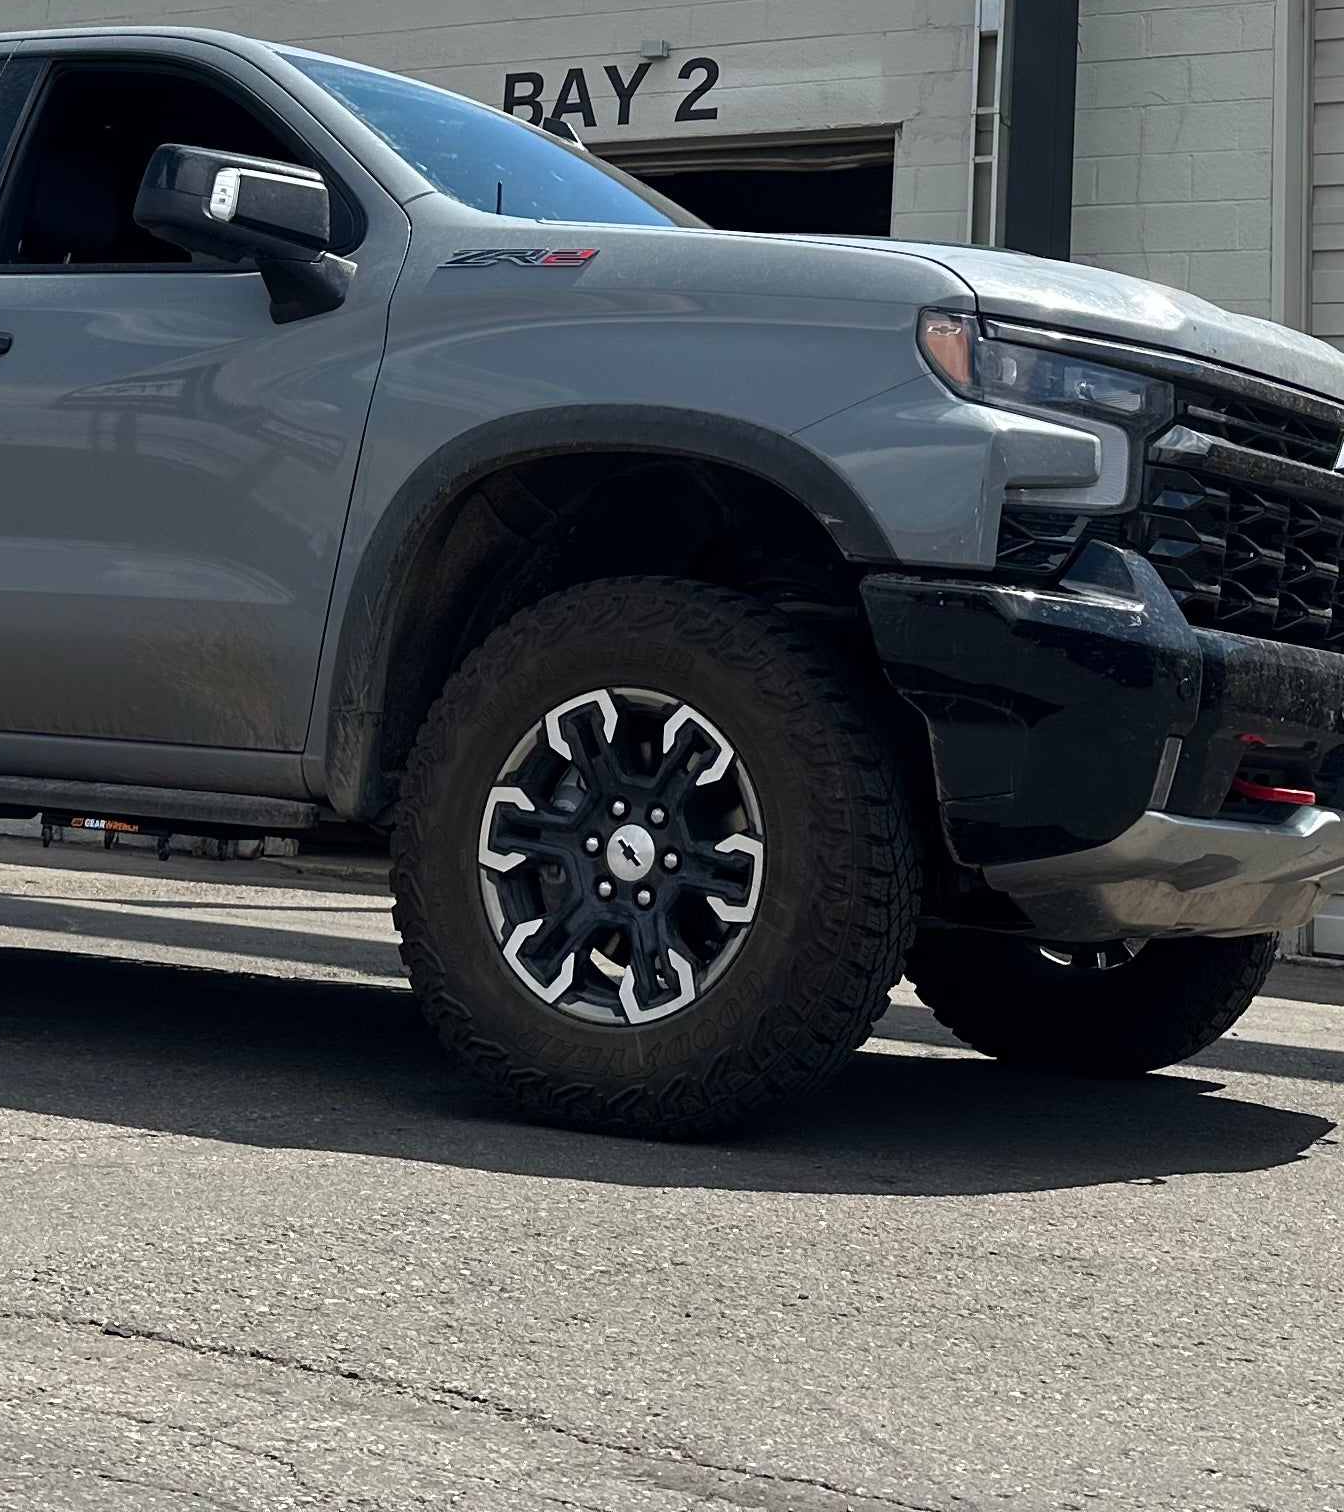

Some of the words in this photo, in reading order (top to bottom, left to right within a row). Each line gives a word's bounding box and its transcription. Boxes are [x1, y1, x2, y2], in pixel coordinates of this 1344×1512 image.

[503, 62, 653, 129] BAY
[674, 57, 720, 123] 2
[437, 248, 601, 268] ZR2
